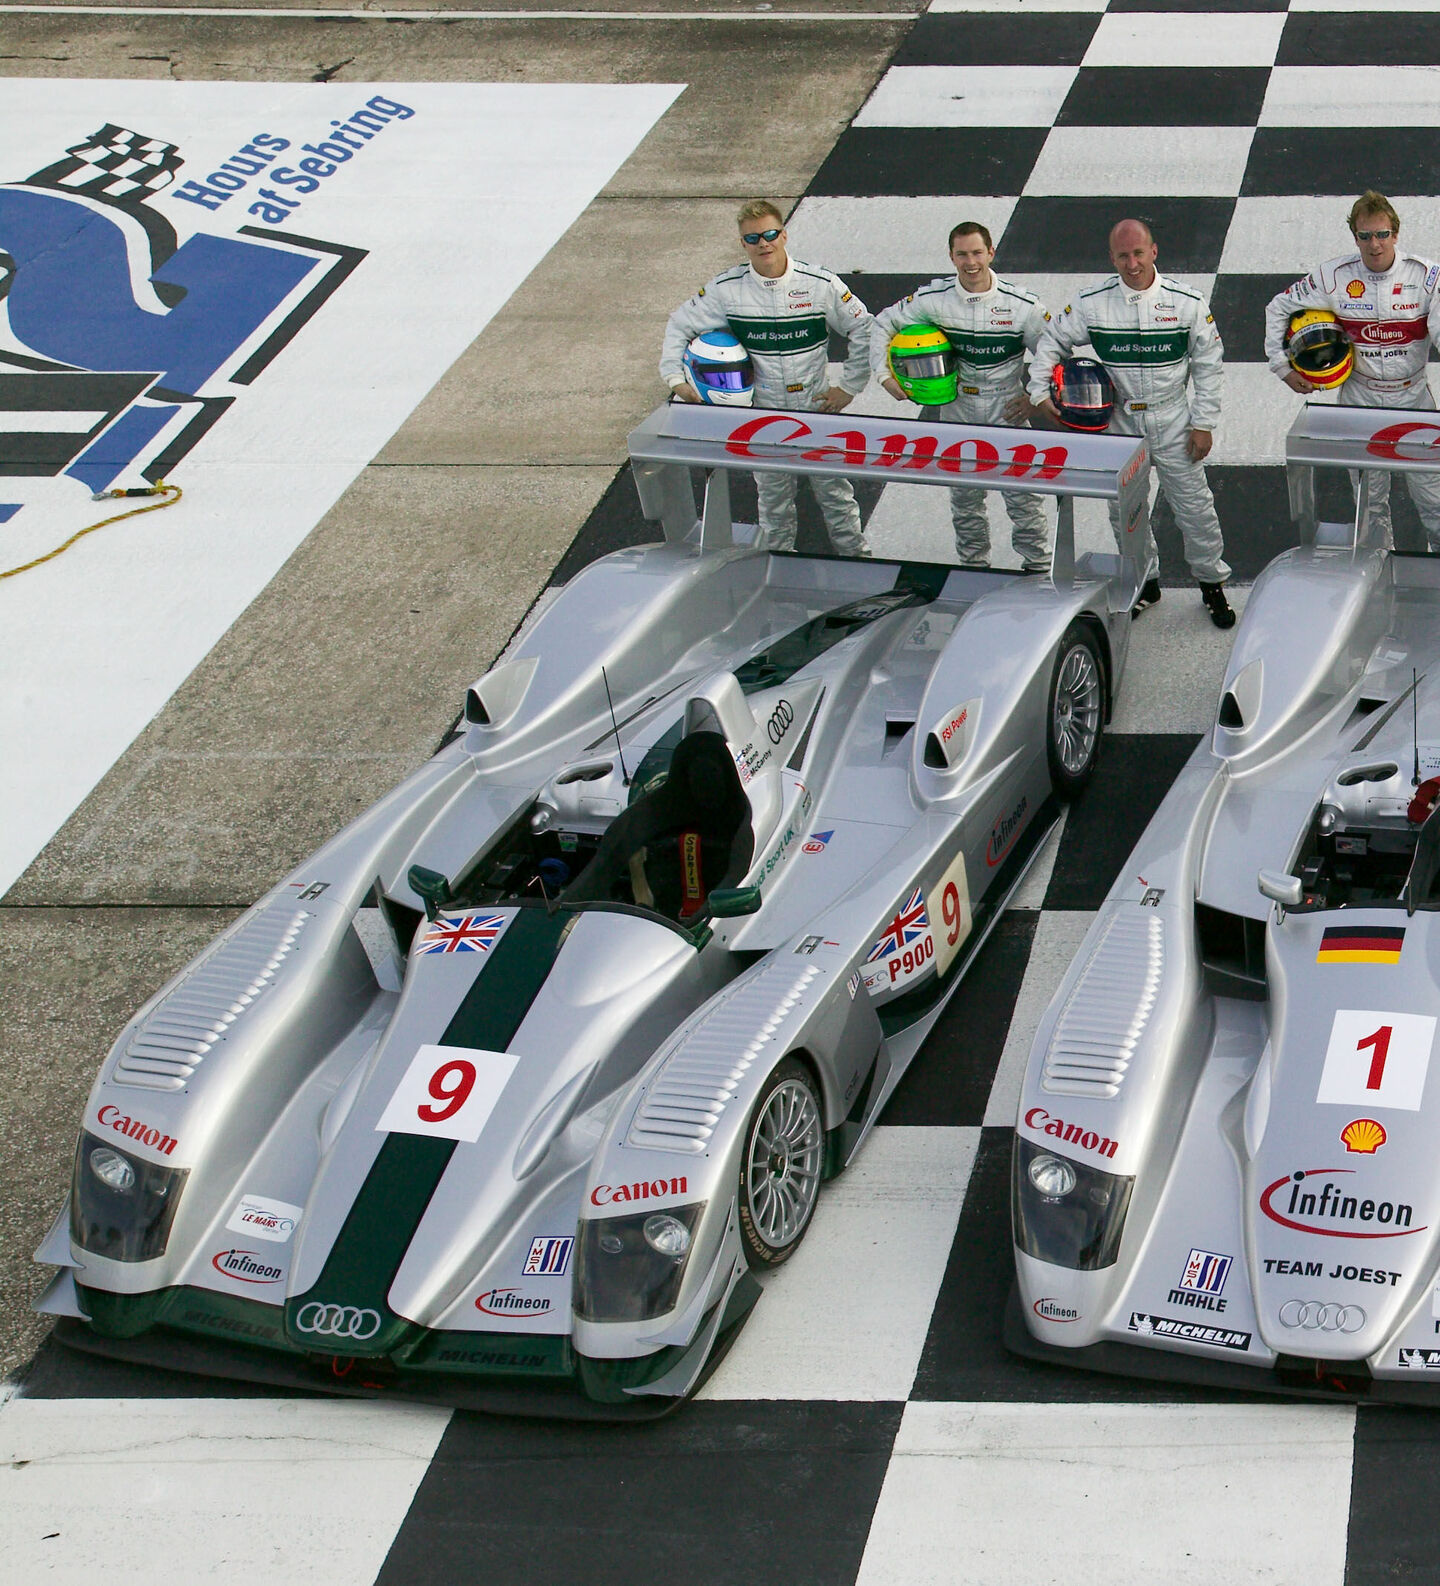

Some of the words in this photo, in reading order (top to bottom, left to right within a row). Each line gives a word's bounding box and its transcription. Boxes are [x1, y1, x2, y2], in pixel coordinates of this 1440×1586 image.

[270, 95, 416, 193] Sebring
[172, 131, 291, 211] Hours
[247, 187, 301, 225] at
[747, 331, 767, 340] Audi
[769, 331, 793, 341] Sport
[795, 328, 809, 338] UK
[992, 346, 1005, 354] UK
[1110, 344, 1130, 352] Audi
[1133, 343, 1156, 353] Sport
[1158, 343, 1172, 352] UK
[1384, 350, 1408, 358] JOEST
[725, 415, 1069, 480] Canon
[749, 749, 773, 777] McCarthy
[766, 845, 785, 874] Sport
[784, 824, 795, 847] UK
[941, 881, 962, 947] 9
[888, 935, 934, 983] P900
[1356, 1025, 1394, 1090] 1
[416, 1059, 477, 1124] 9
[97, 1104, 180, 1157] Canon
[1024, 1107, 1120, 1160] Canon
[590, 1175, 689, 1207] Canon
[241, 1213, 253, 1222] LE
[254, 1215, 279, 1228] MANS
[1263, 1259, 1324, 1279] TEAM
[1329, 1264, 1402, 1287] JOEST
[1167, 1289, 1228, 1313] MAHLE
[1155, 1318, 1250, 1348] MICHELIN
[438, 1348, 548, 1368] MICHELIN
